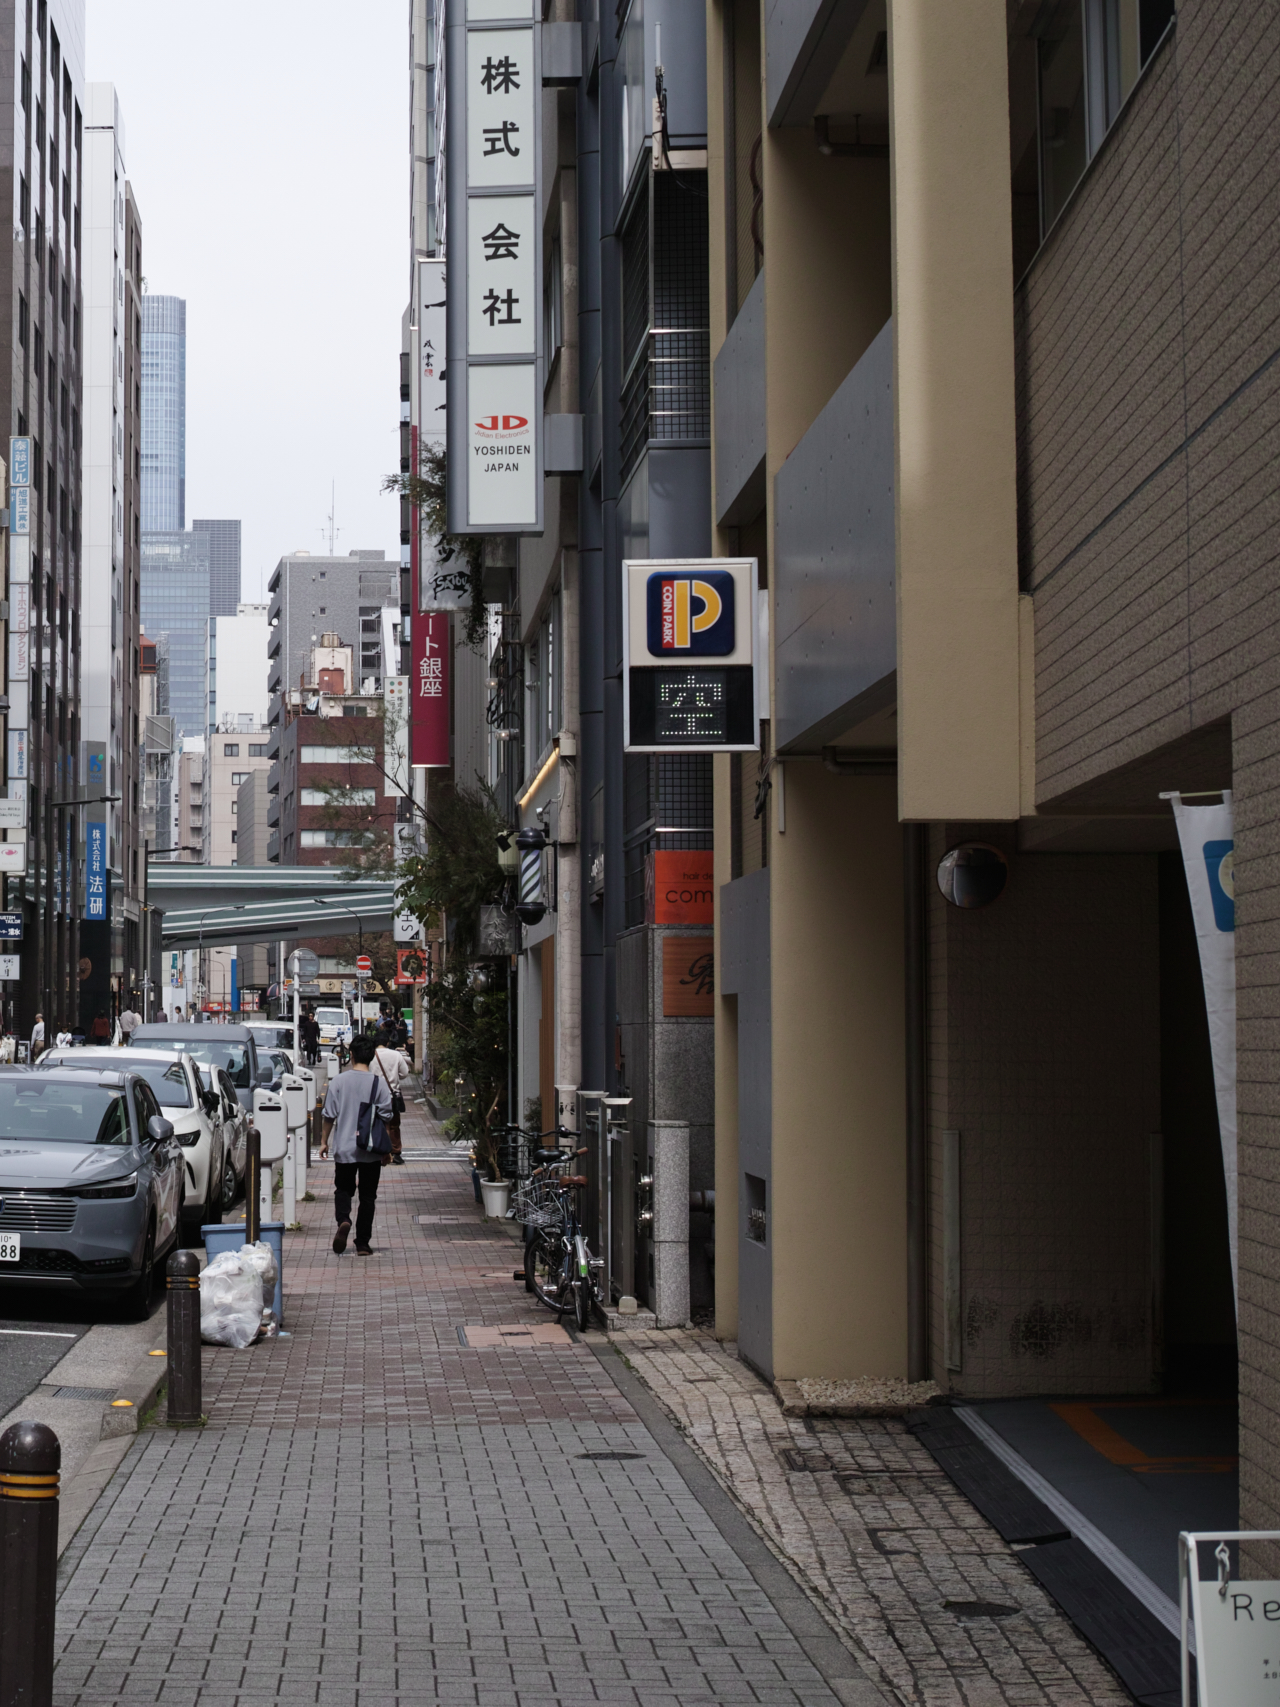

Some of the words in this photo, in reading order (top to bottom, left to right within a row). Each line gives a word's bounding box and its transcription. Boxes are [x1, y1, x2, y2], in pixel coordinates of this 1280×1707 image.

[480, 55, 522, 327] 株式会社
[494, 428, 530, 440] Electronics
[474, 444, 531, 456] YOSHIDEN
[484, 462, 519, 473] JAPAN
[662, 586, 673, 613] COIN
[662, 615, 673, 644] PARK
[420, 612, 443, 698] ート銀座
[660, 675, 722, 736] 空
[91, 828, 101, 872] 株式会社
[683, 872, 700, 881] hair
[89, 875, 103, 915] 法研
